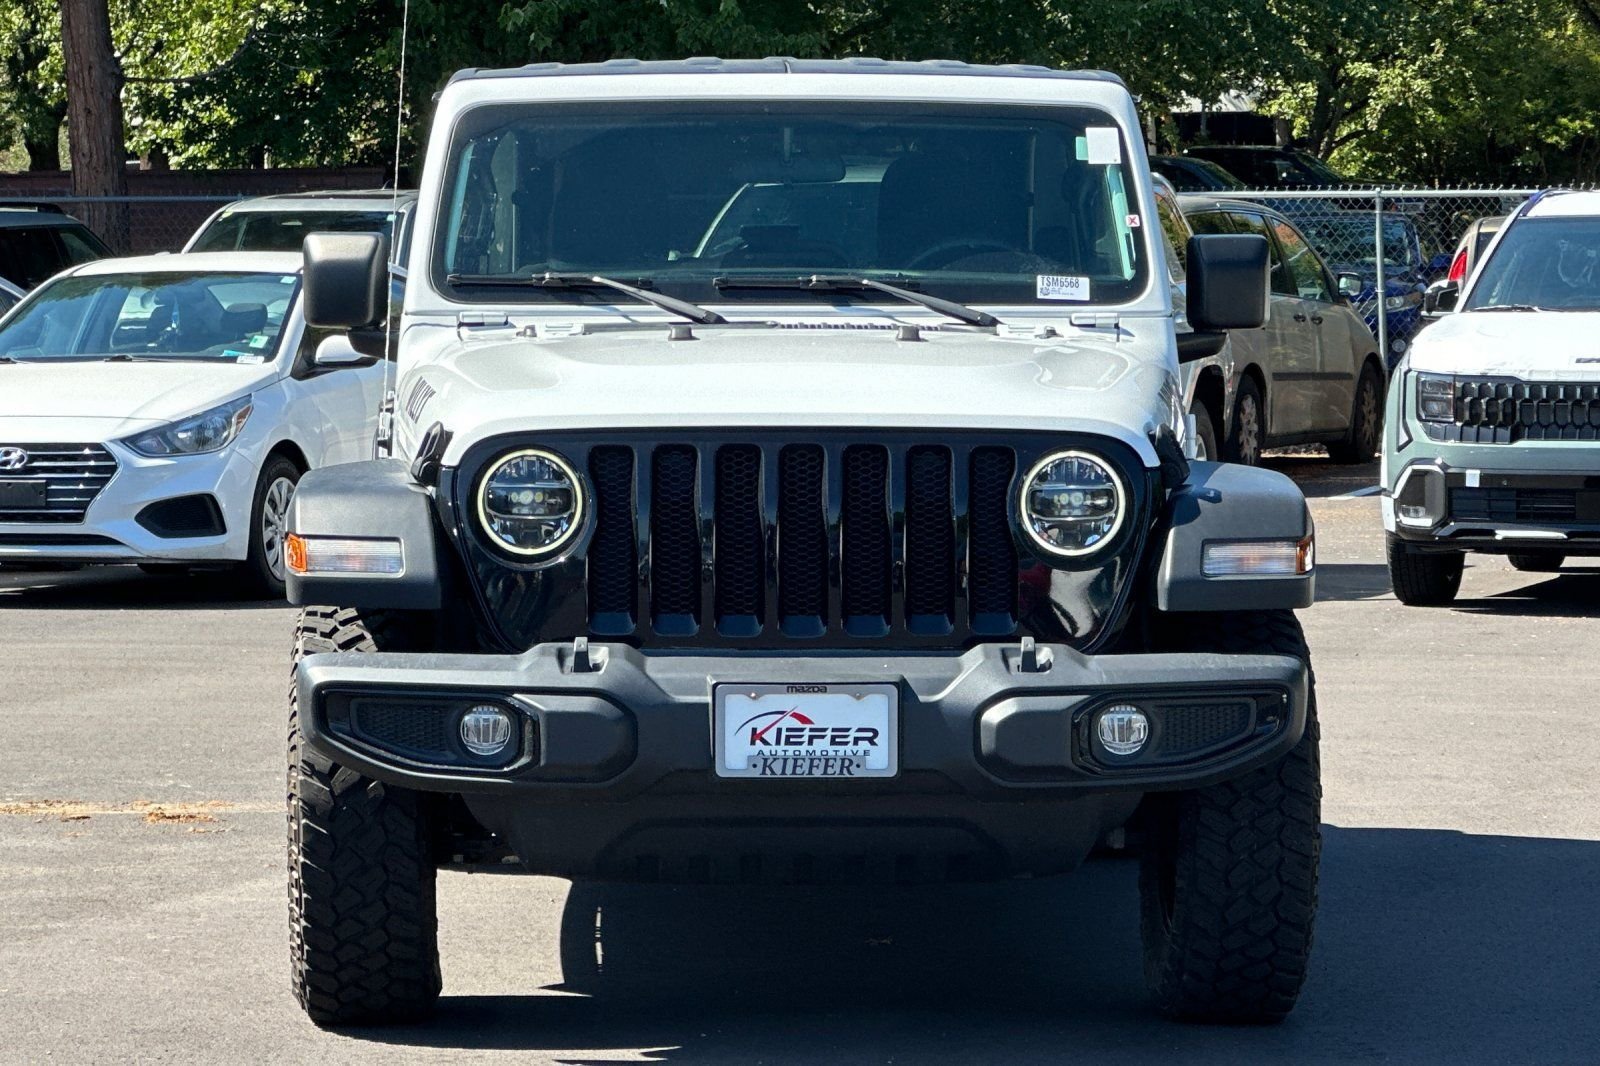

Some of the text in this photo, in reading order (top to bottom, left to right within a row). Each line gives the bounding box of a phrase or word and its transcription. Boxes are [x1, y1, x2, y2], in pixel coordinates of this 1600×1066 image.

[1040, 276, 1080, 289] TSM6568
[750, 727, 880, 747] KIEFER
[756, 749, 871, 757] AUTOMOTIVE
[759, 757, 855, 776] KIEFER
